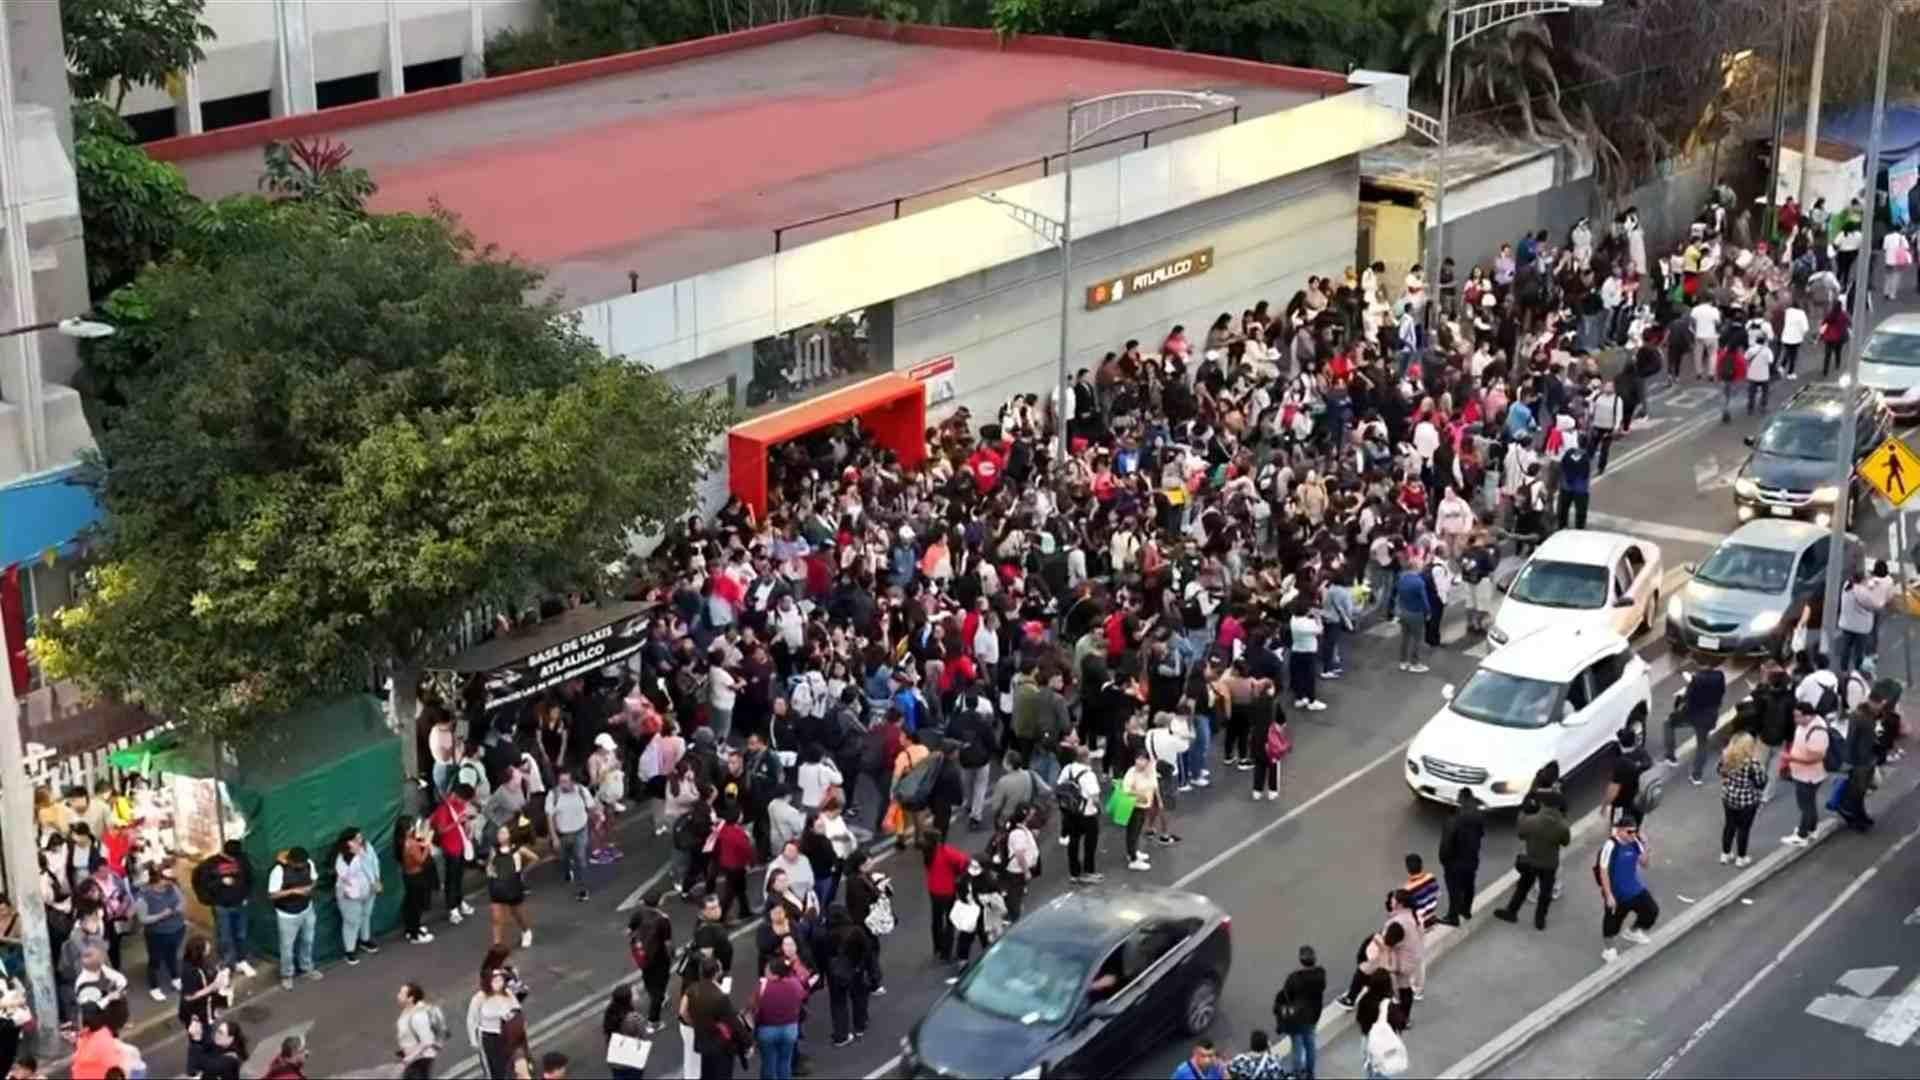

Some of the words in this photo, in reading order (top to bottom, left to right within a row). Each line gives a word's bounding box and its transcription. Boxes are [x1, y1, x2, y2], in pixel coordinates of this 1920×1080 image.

[528, 646, 560, 667] BASE
[562, 638, 579, 654] DE
[580, 625, 613, 646] TAXIS
